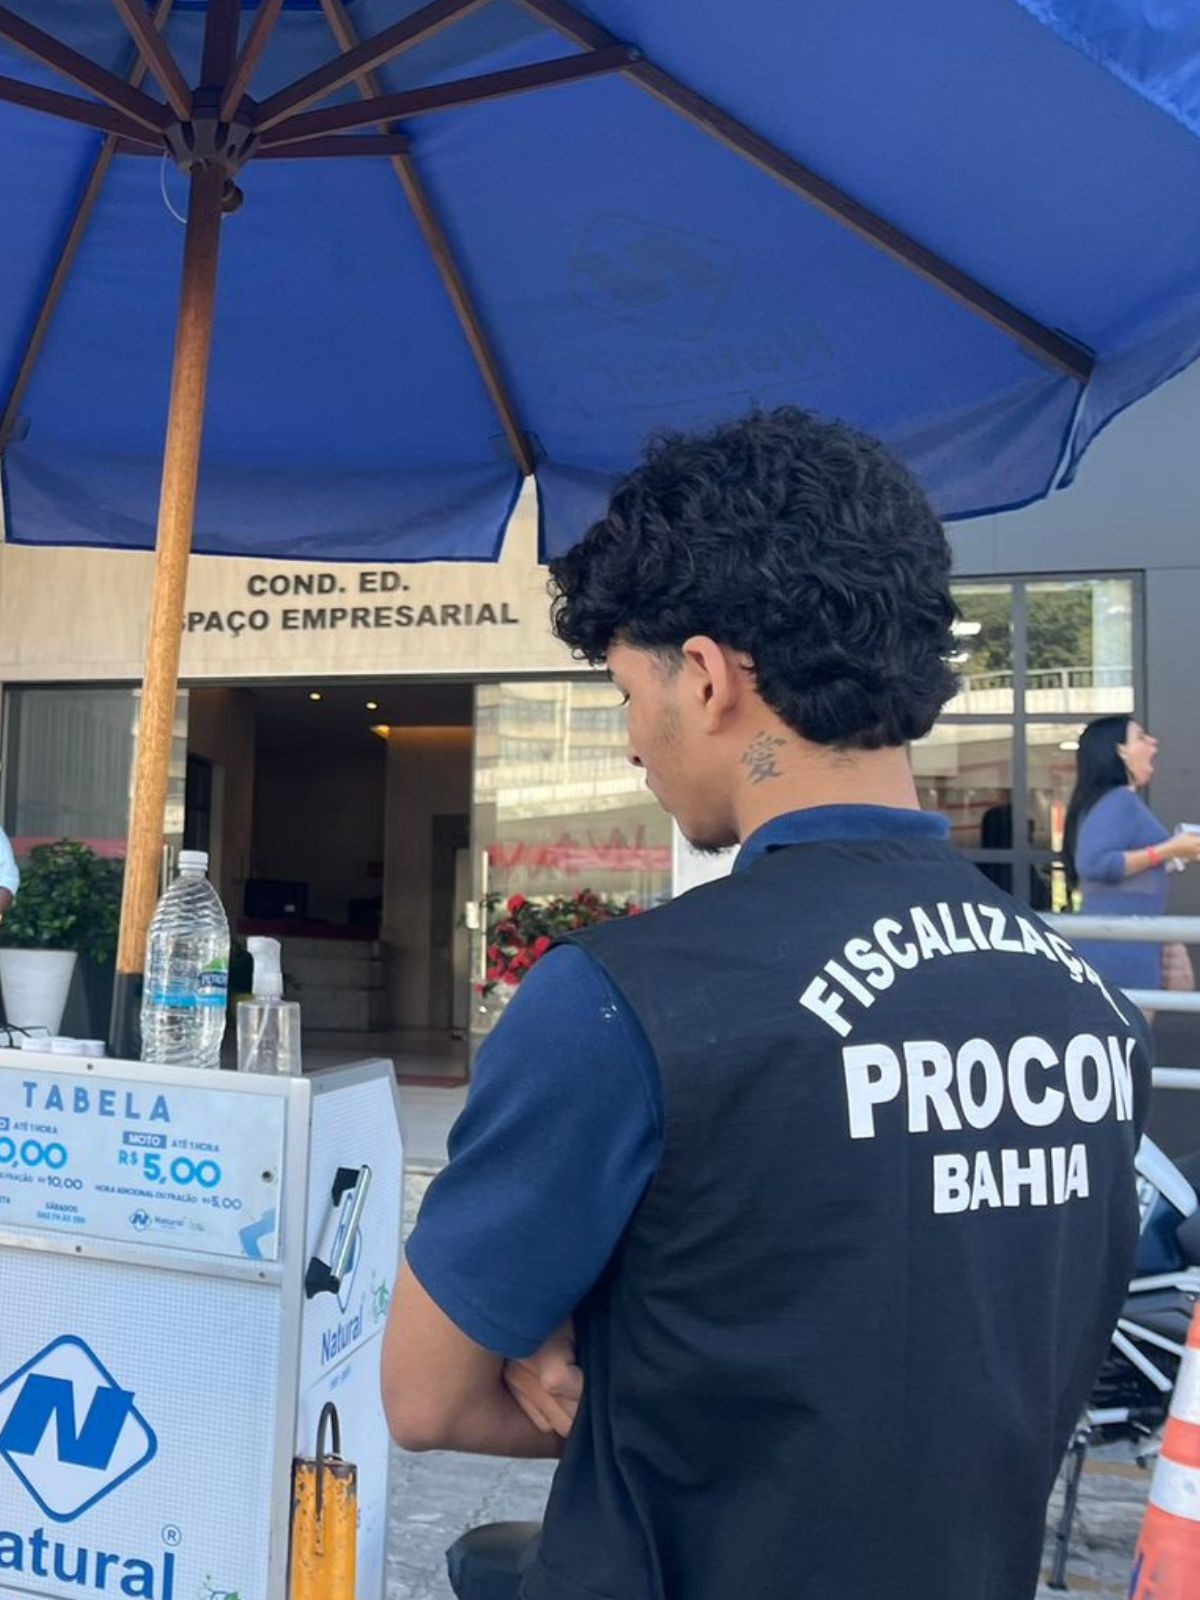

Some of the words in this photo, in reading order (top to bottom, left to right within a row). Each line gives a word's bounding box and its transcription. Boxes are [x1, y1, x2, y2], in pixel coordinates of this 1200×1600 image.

[247, 573, 346, 597] COND.
[359, 571, 410, 594] ED.
[181, 608, 270, 638] PAÇO
[281, 602, 520, 631] EMPRESARIAL
[21, 1080, 172, 1124] TABELA
[842, 1033, 1136, 1139] PROCON
[129, 1133, 161, 1147] MOTO
[47, 1175, 83, 1190] 10,00
[118, 1149, 139, 1166] R$
[143, 1151, 222, 1189] 5,00
[932, 1143, 1090, 1214] BAHIA
[211, 1195, 243, 1211] 5,00
[321, 1310, 362, 1366] Natural
